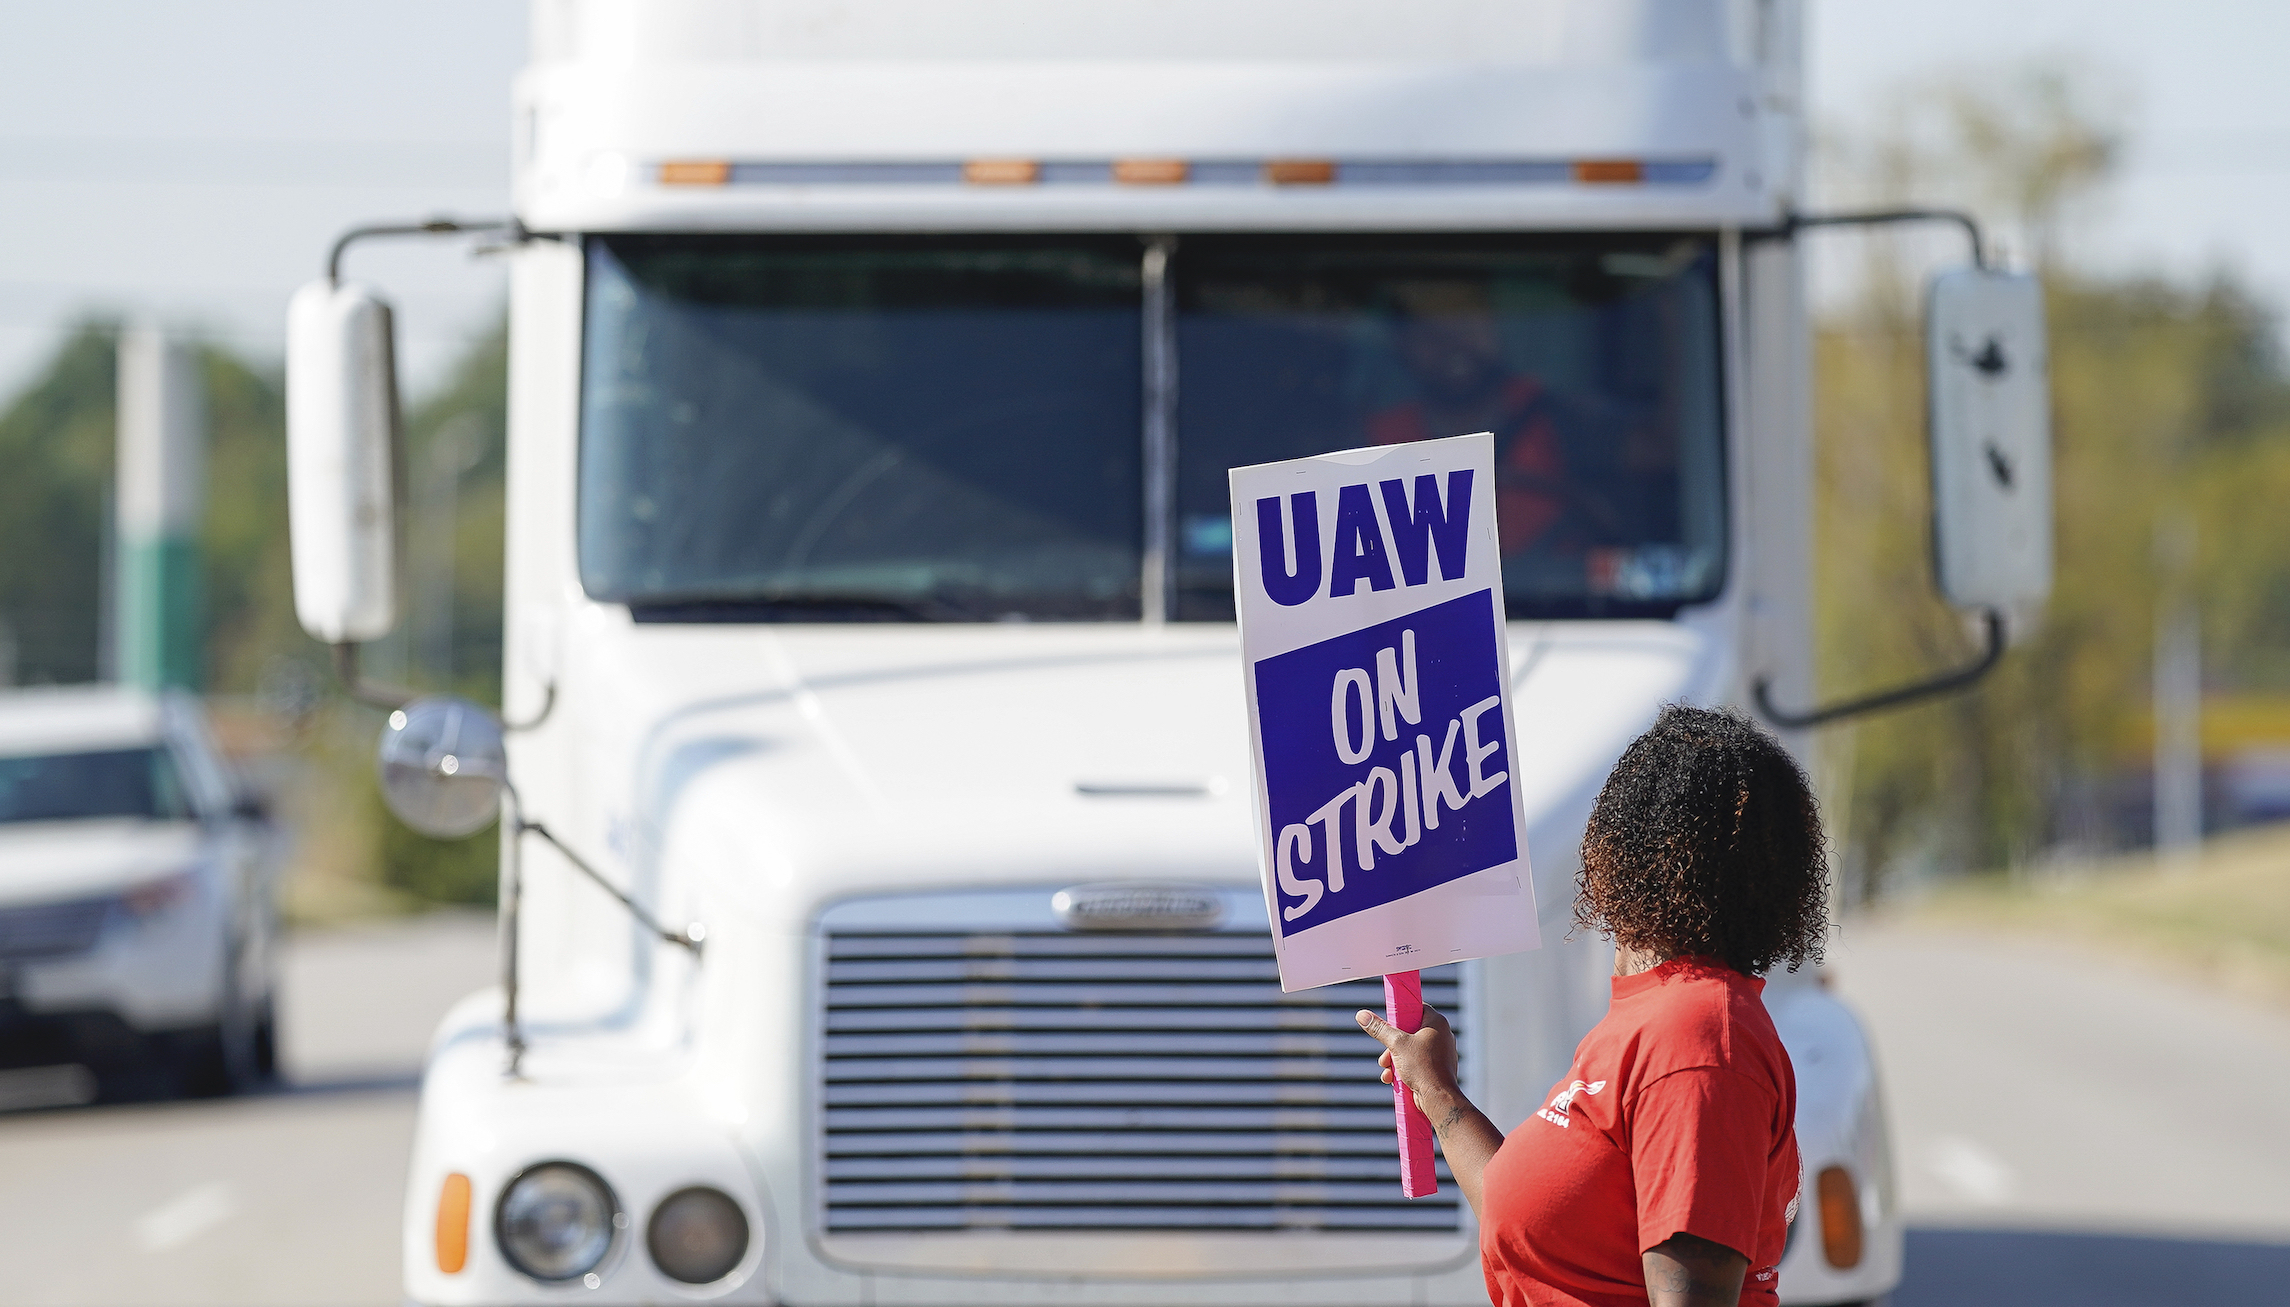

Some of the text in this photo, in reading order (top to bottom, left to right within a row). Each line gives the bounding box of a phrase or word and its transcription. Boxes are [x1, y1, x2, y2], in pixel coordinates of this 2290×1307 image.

[1256, 469, 1475, 606] UAW
[1331, 629, 1421, 765] ON
[1277, 695, 1507, 922] STRIKE
